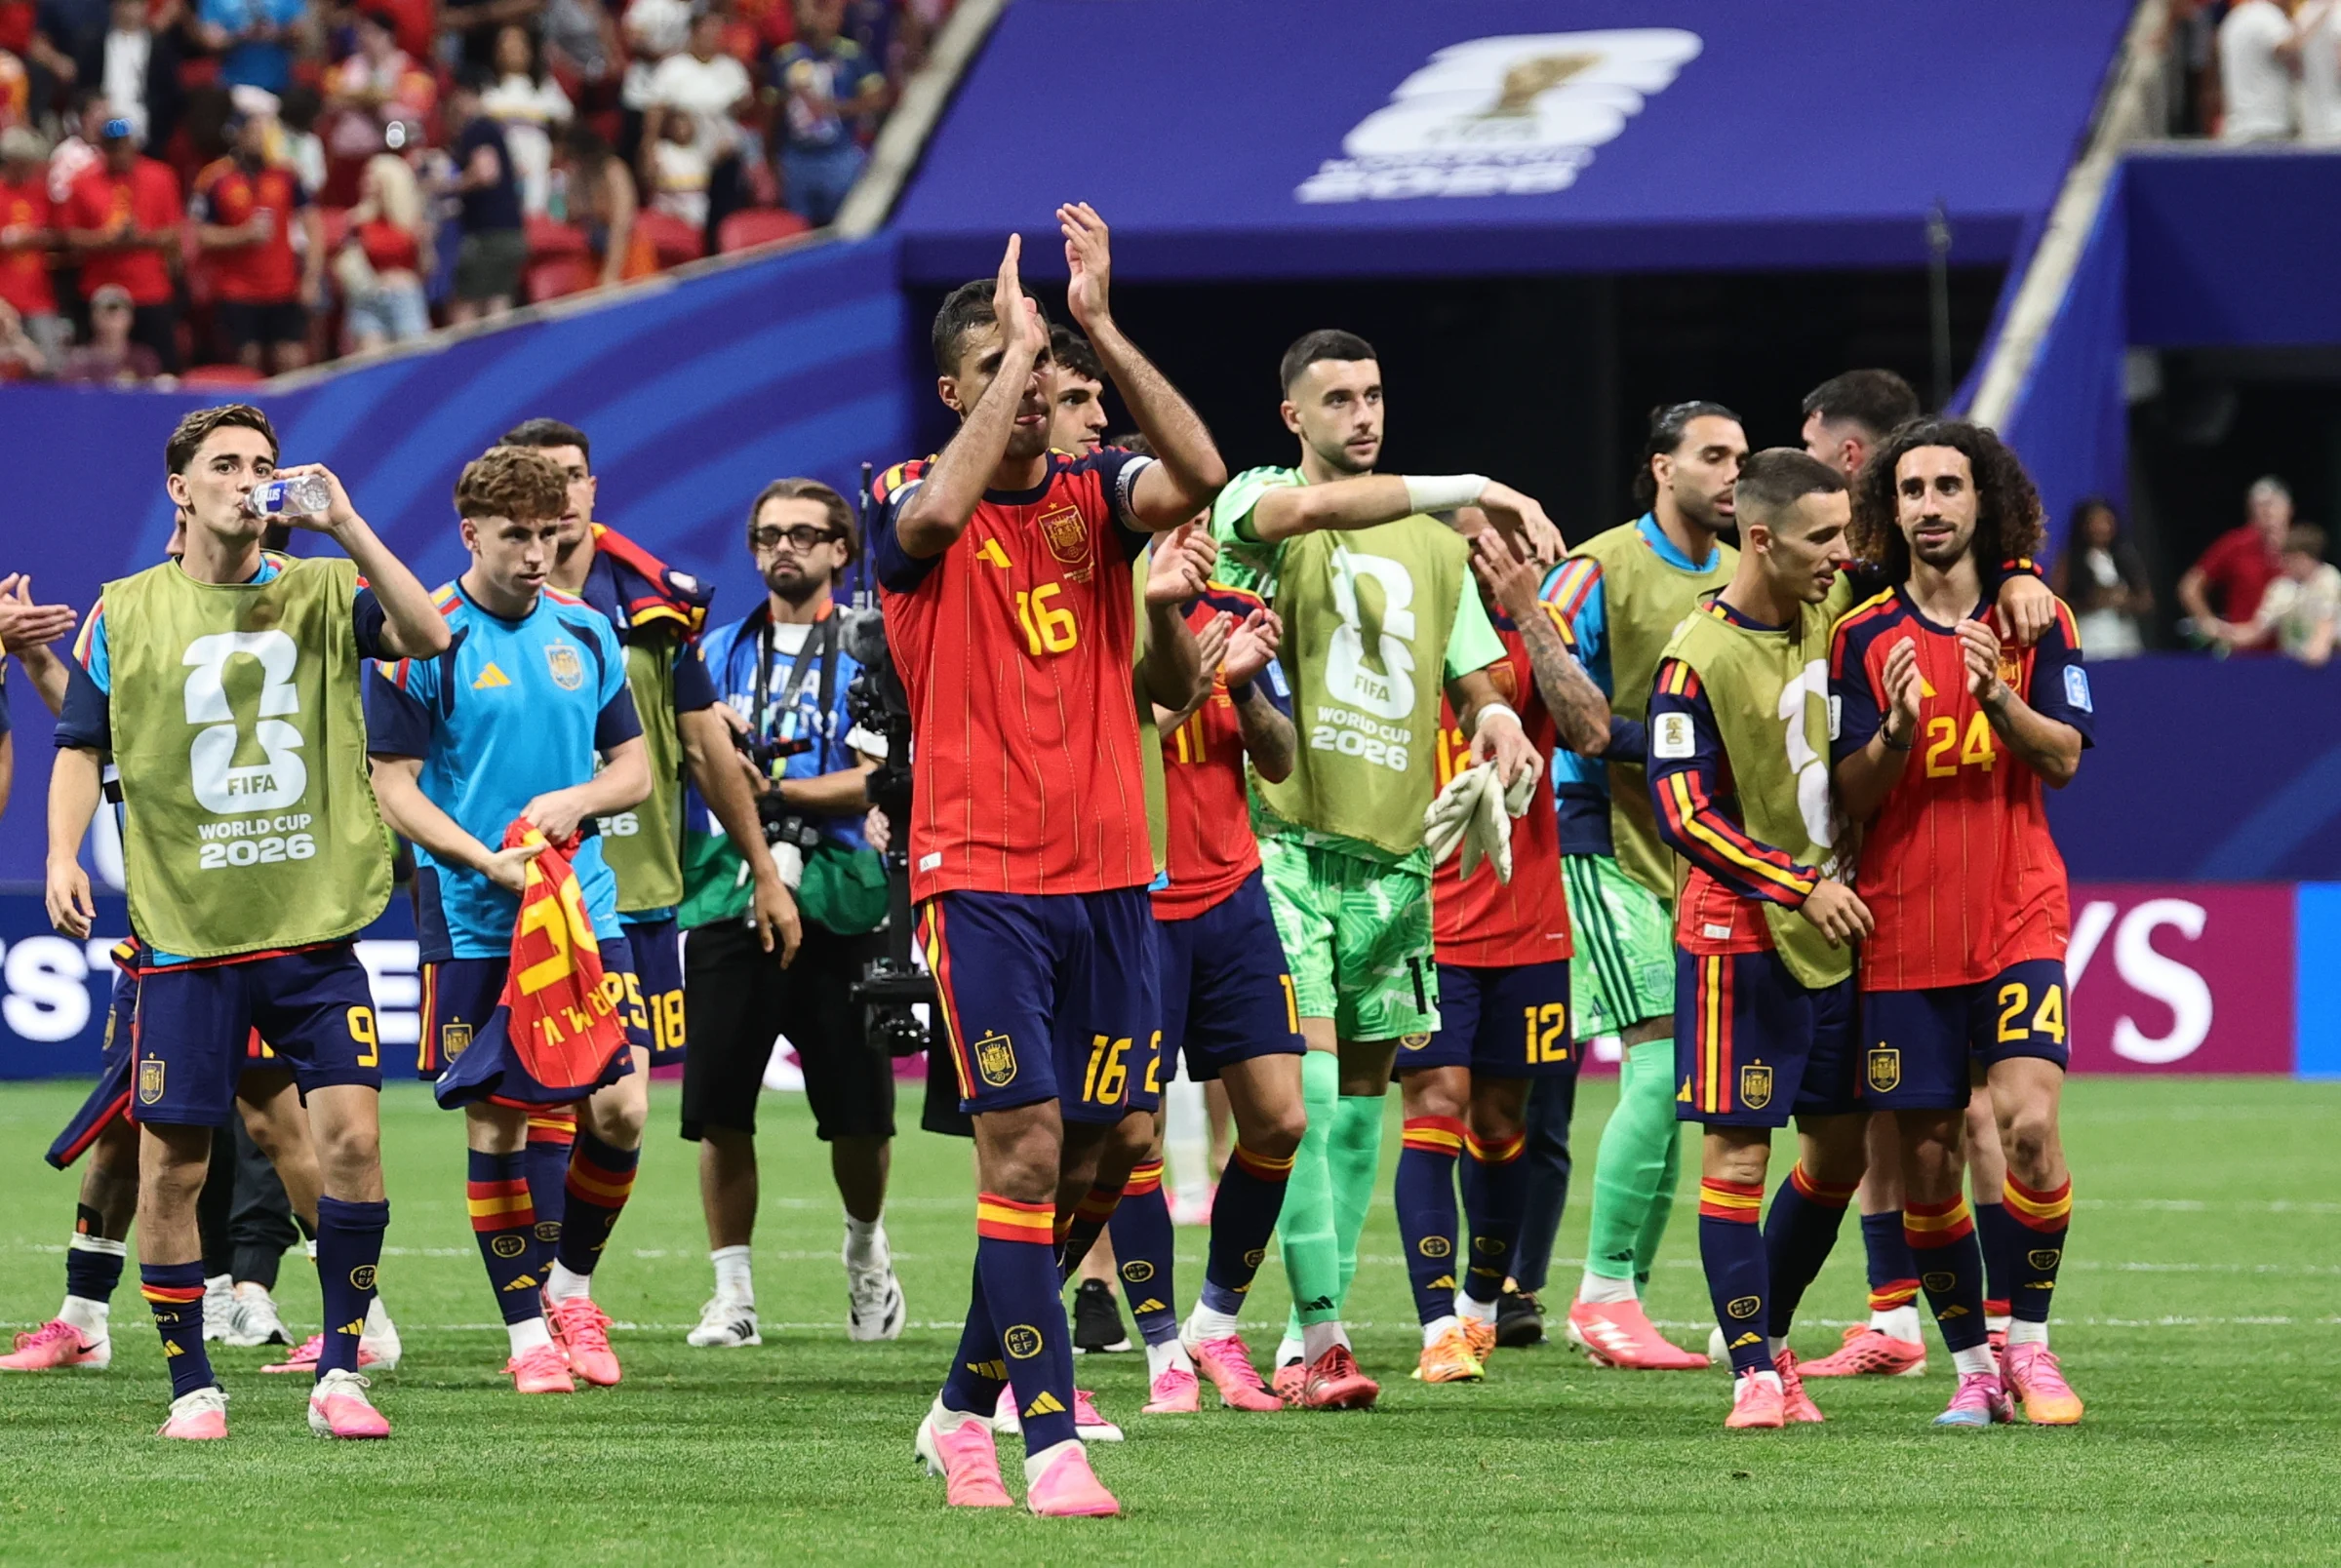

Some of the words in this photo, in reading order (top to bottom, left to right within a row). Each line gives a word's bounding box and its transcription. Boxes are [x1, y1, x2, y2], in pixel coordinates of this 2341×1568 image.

[1016, 581, 1078, 656] 16
[1354, 675, 1391, 702] FIFA
[1317, 706, 1377, 735] WORLD
[1379, 725, 1411, 744] CUP
[1926, 710, 1997, 778] 24
[1311, 725, 1409, 772] 2026
[227, 773, 279, 797] FIFA
[198, 818, 270, 841] WORLD
[273, 813, 312, 833] CUP
[595, 811, 639, 838] 26
[199, 833, 316, 870] 2026
[650, 989, 686, 1051] 18
[1524, 1002, 1567, 1064] 12
[1998, 982, 2065, 1044] 24
[346, 1005, 379, 1068] 9
[1082, 1034, 1132, 1105] 16
[1011, 1331, 1030, 1343] RF
[1012, 1340, 1033, 1352] EF
